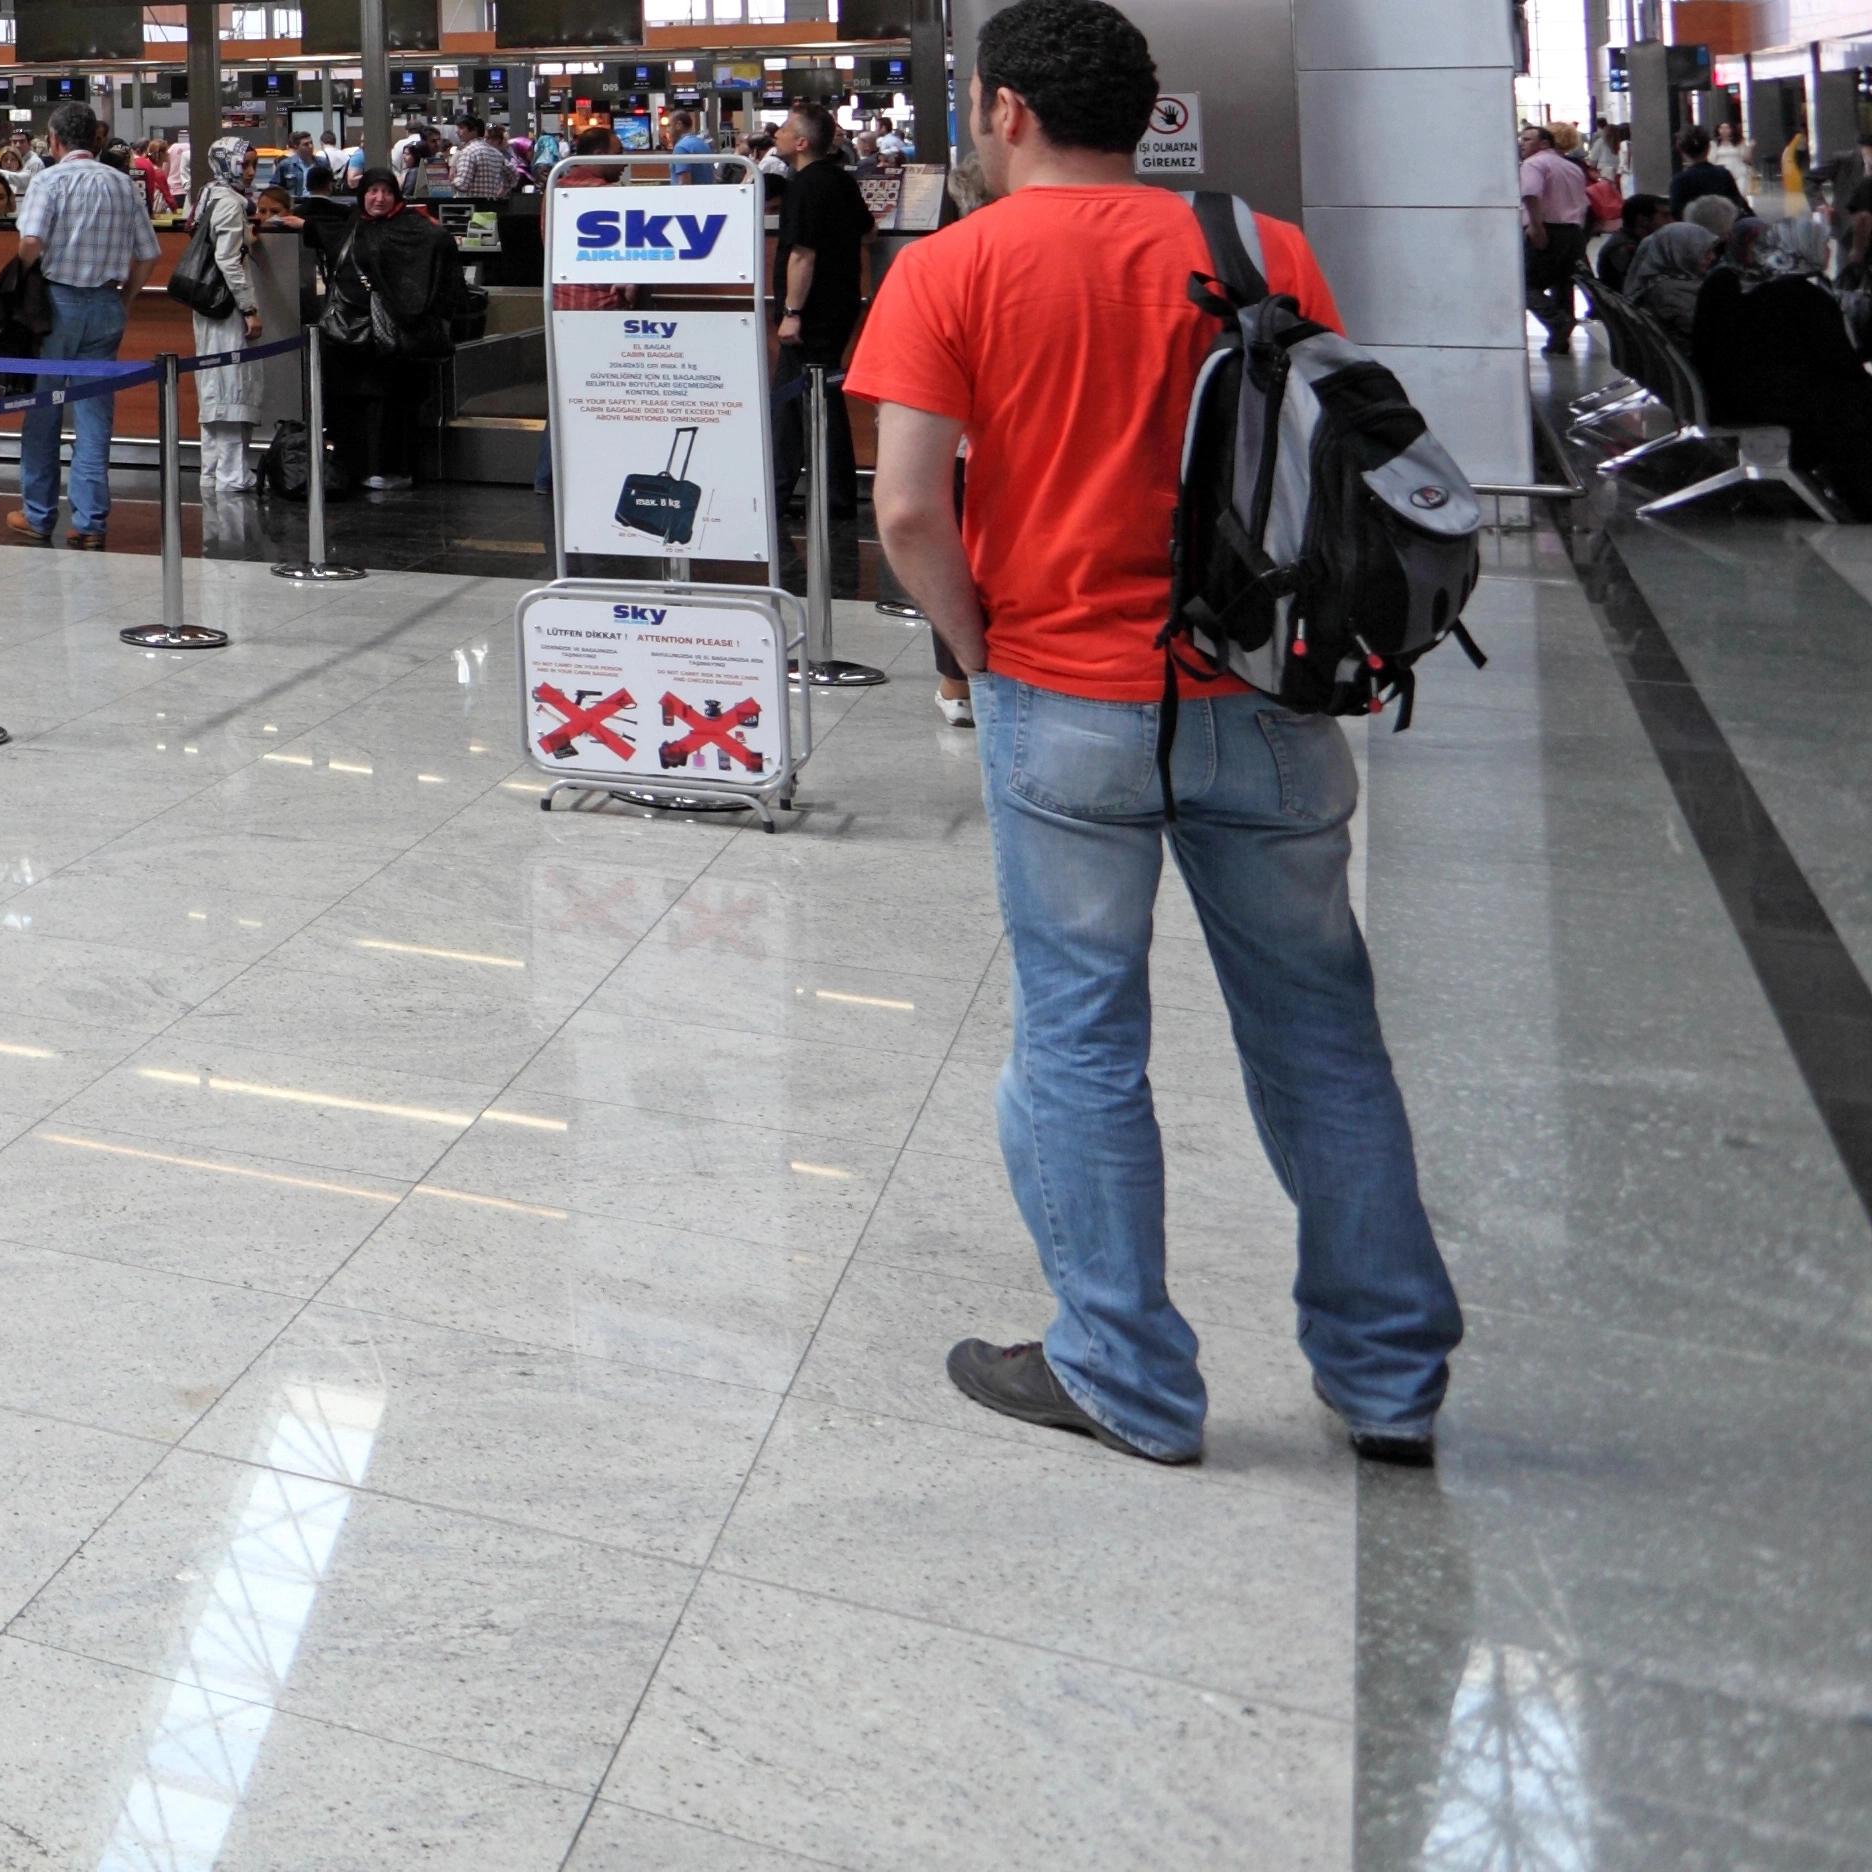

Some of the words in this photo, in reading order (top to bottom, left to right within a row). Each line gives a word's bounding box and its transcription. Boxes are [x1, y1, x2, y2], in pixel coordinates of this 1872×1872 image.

[1153, 142, 1198, 153] OLMAYAN
[576, 249, 676, 261] AIRLINES
[668, 498, 681, 509] kg
[547, 627, 582, 638] LÜTFEN
[637, 634, 692, 645] ATTENTION
[696, 637, 733, 647] PLEASE
